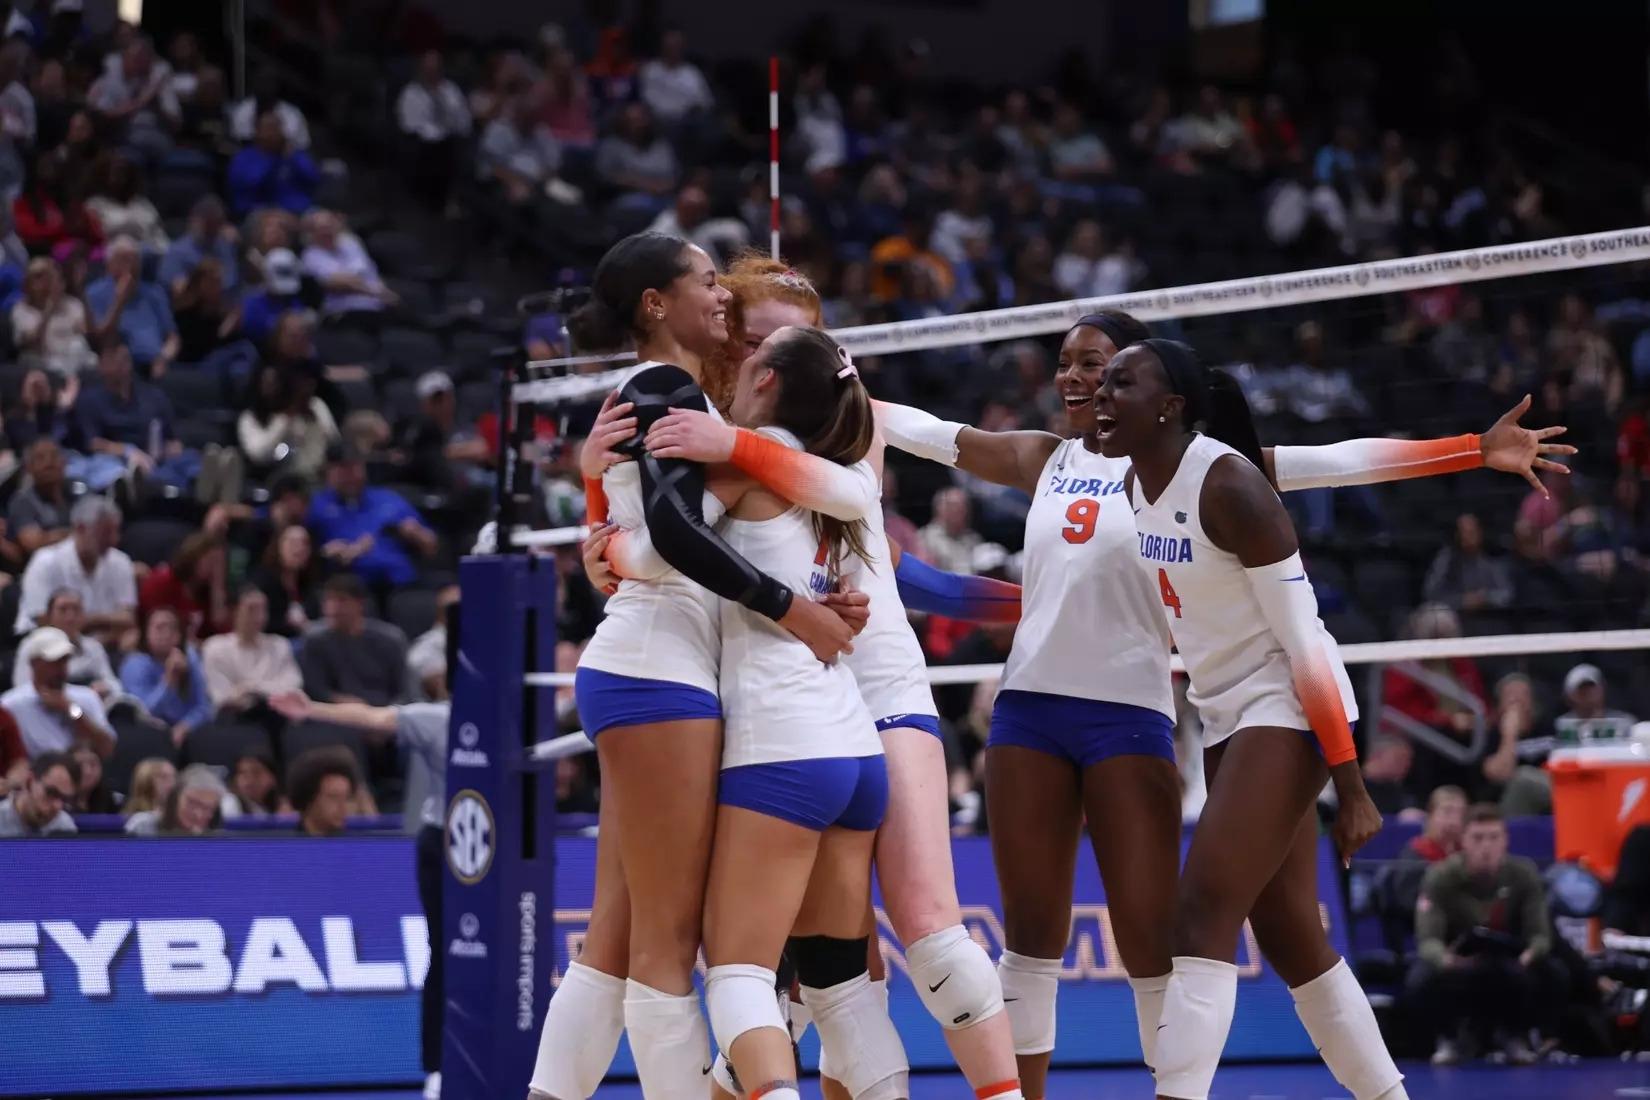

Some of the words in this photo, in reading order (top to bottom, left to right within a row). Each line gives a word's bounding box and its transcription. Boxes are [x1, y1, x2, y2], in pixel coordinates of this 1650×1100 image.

[1374, 258, 1462, 279] SOUTHEASTERN
[1482, 244, 1568, 265] CONFERENCE
[1590, 234, 1650, 253] SOUTHEA
[1062, 499, 1100, 544] 9
[1138, 531, 1193, 562] LORIDA
[1158, 568, 1182, 618] 4
[449, 797, 490, 876] SEC
[519, 891, 536, 954] sports
[517, 954, 535, 1031] imports
